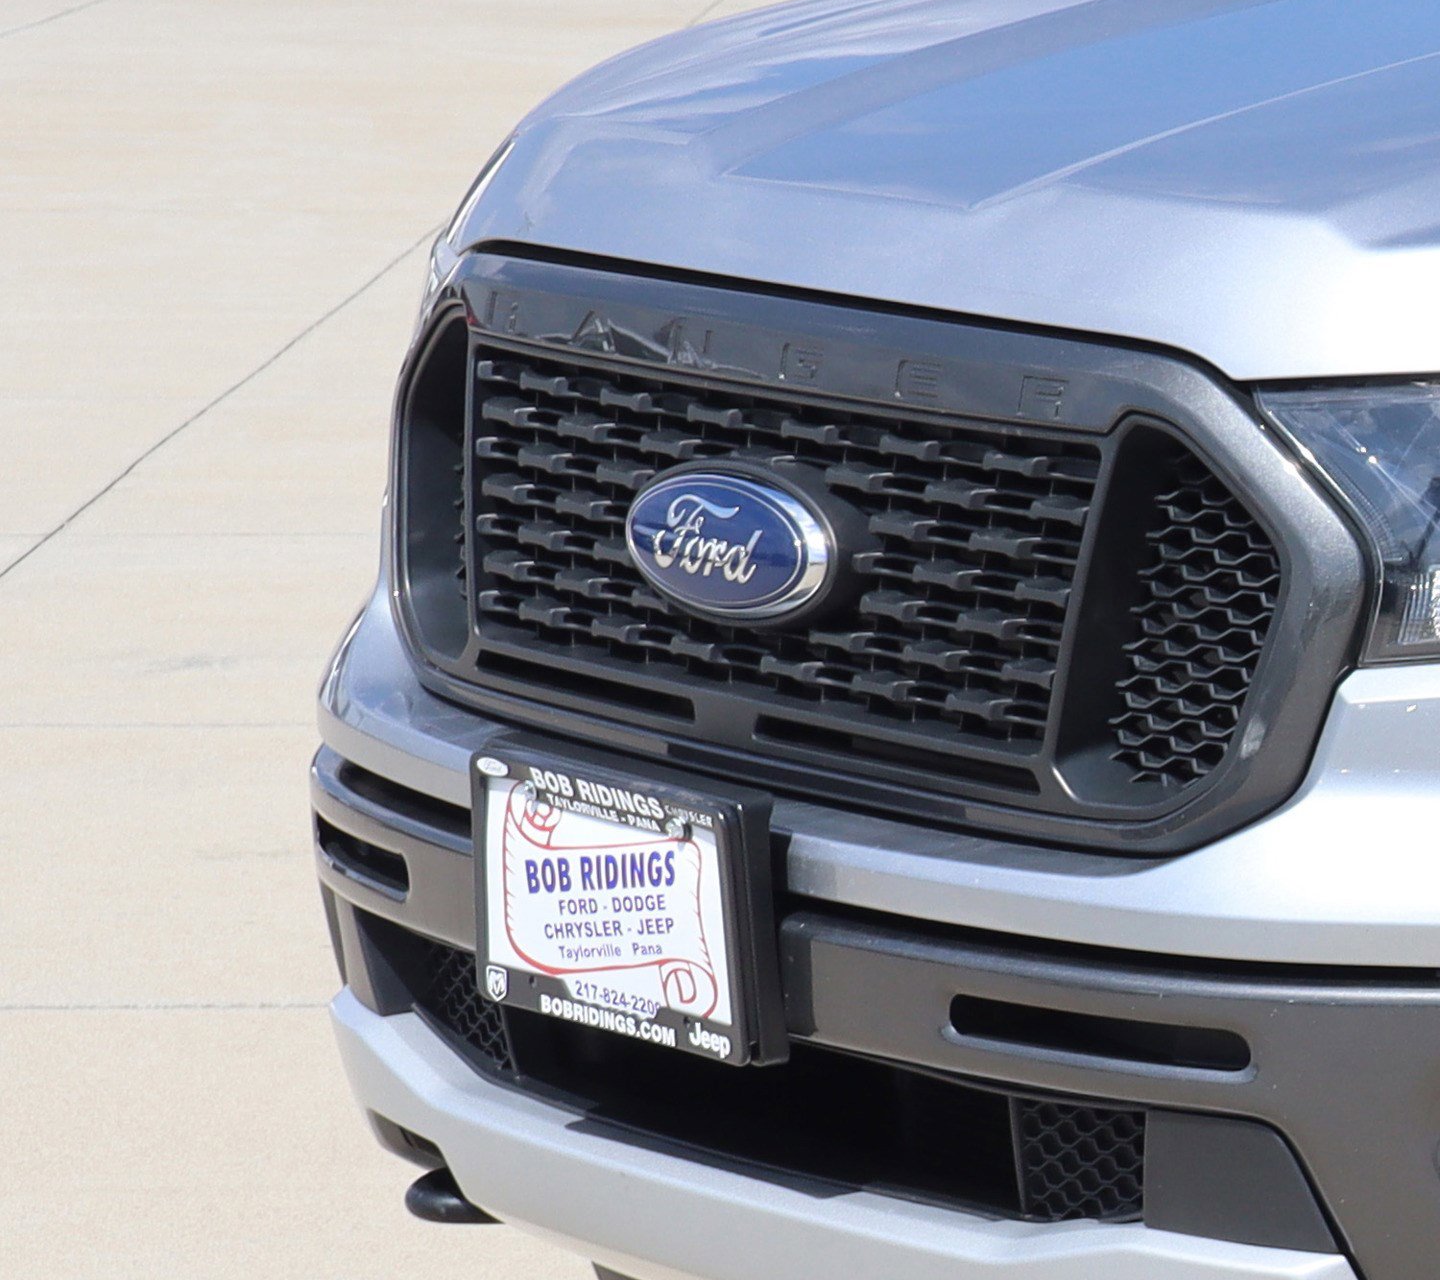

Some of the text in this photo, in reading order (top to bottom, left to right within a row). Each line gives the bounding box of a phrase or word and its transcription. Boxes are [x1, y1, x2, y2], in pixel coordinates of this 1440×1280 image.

[652, 493, 764, 585] Ford
[528, 766, 572, 798] BOB
[576, 778, 664, 820] RIDINGS
[545, 793, 620, 824] TAYLORVILLE
[626, 813, 661, 833] PANA
[524, 849, 676, 895] BOB RIDINGS
[558, 898, 598, 916] FORD
[612, 893, 667, 914] DODGE
[544, 920, 623, 940] CHRYSLER
[637, 918, 675, 936] JEEP
[558, 941, 663, 963] Taylorville Pana
[540, 994, 677, 1047] BOBRIDINGS.COM
[689, 1021, 731, 1058] Jeep
